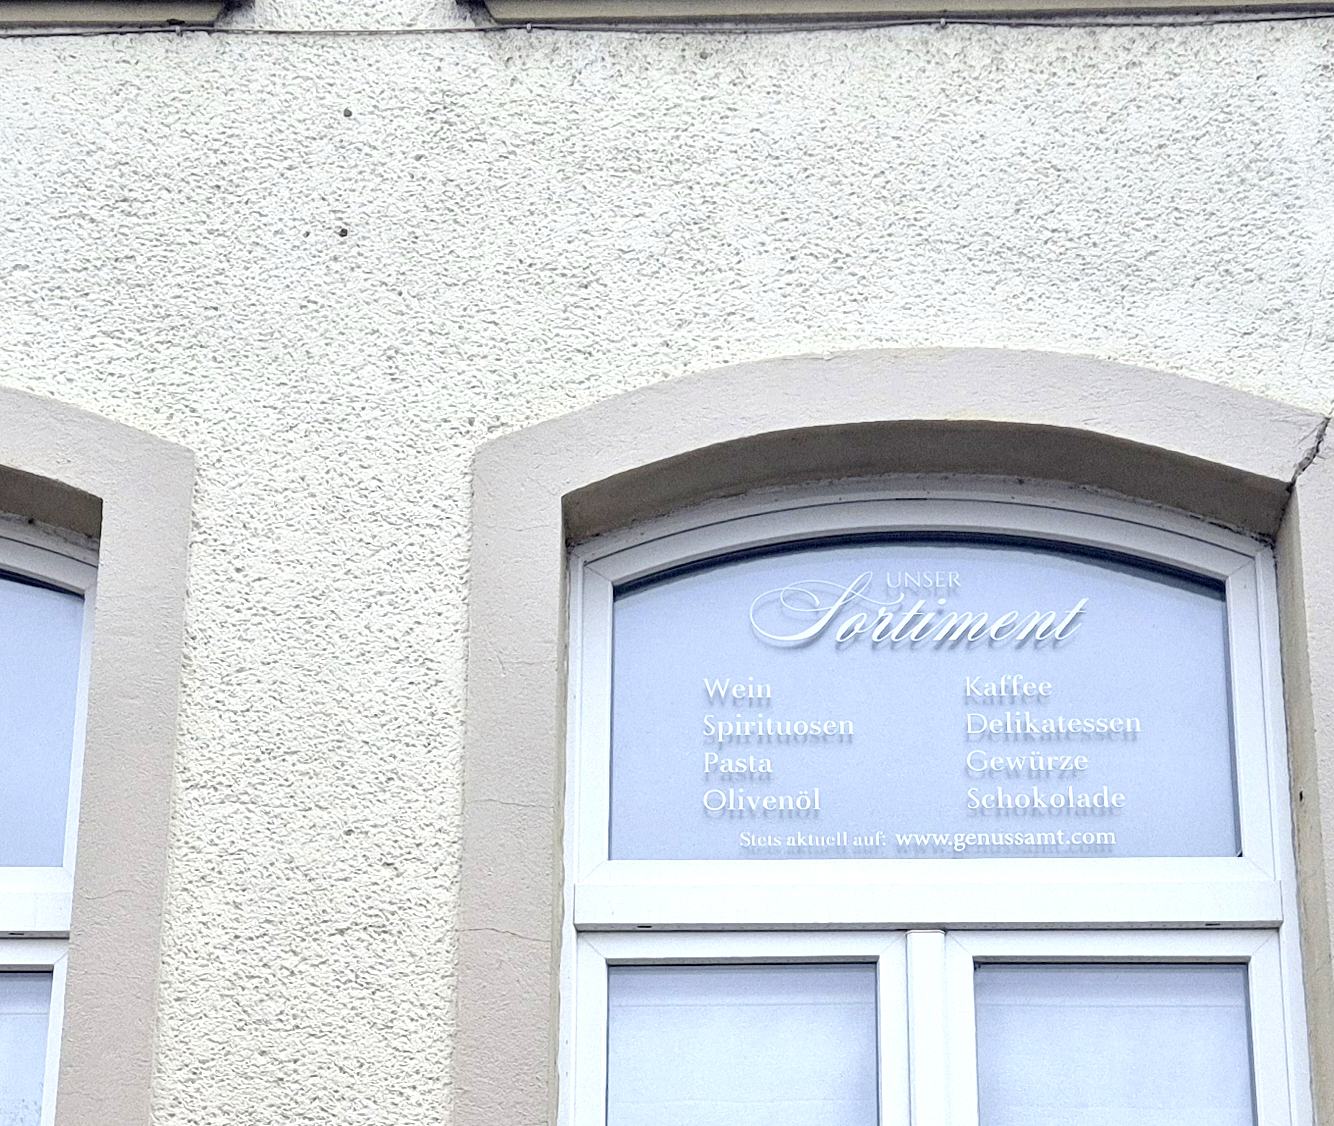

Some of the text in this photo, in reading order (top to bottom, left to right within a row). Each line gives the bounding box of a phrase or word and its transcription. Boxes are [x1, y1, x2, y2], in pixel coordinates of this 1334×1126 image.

[886, 571, 961, 588] UNSER
[750, 571, 1089, 643] Sortiment
[703, 677, 772, 698] Wein
[965, 674, 1053, 697] Kaffee
[703, 713, 854, 742] Spirituosen
[966, 711, 1141, 734] Delikatessen
[704, 752, 773, 773] Pasta
[966, 750, 1088, 772] Gewürze
[703, 787, 821, 811] Olivenöl
[967, 786, 1126, 809] Schokolade
[739, 829, 1117, 851] Stets aktuell auf: www.genussamt.com
